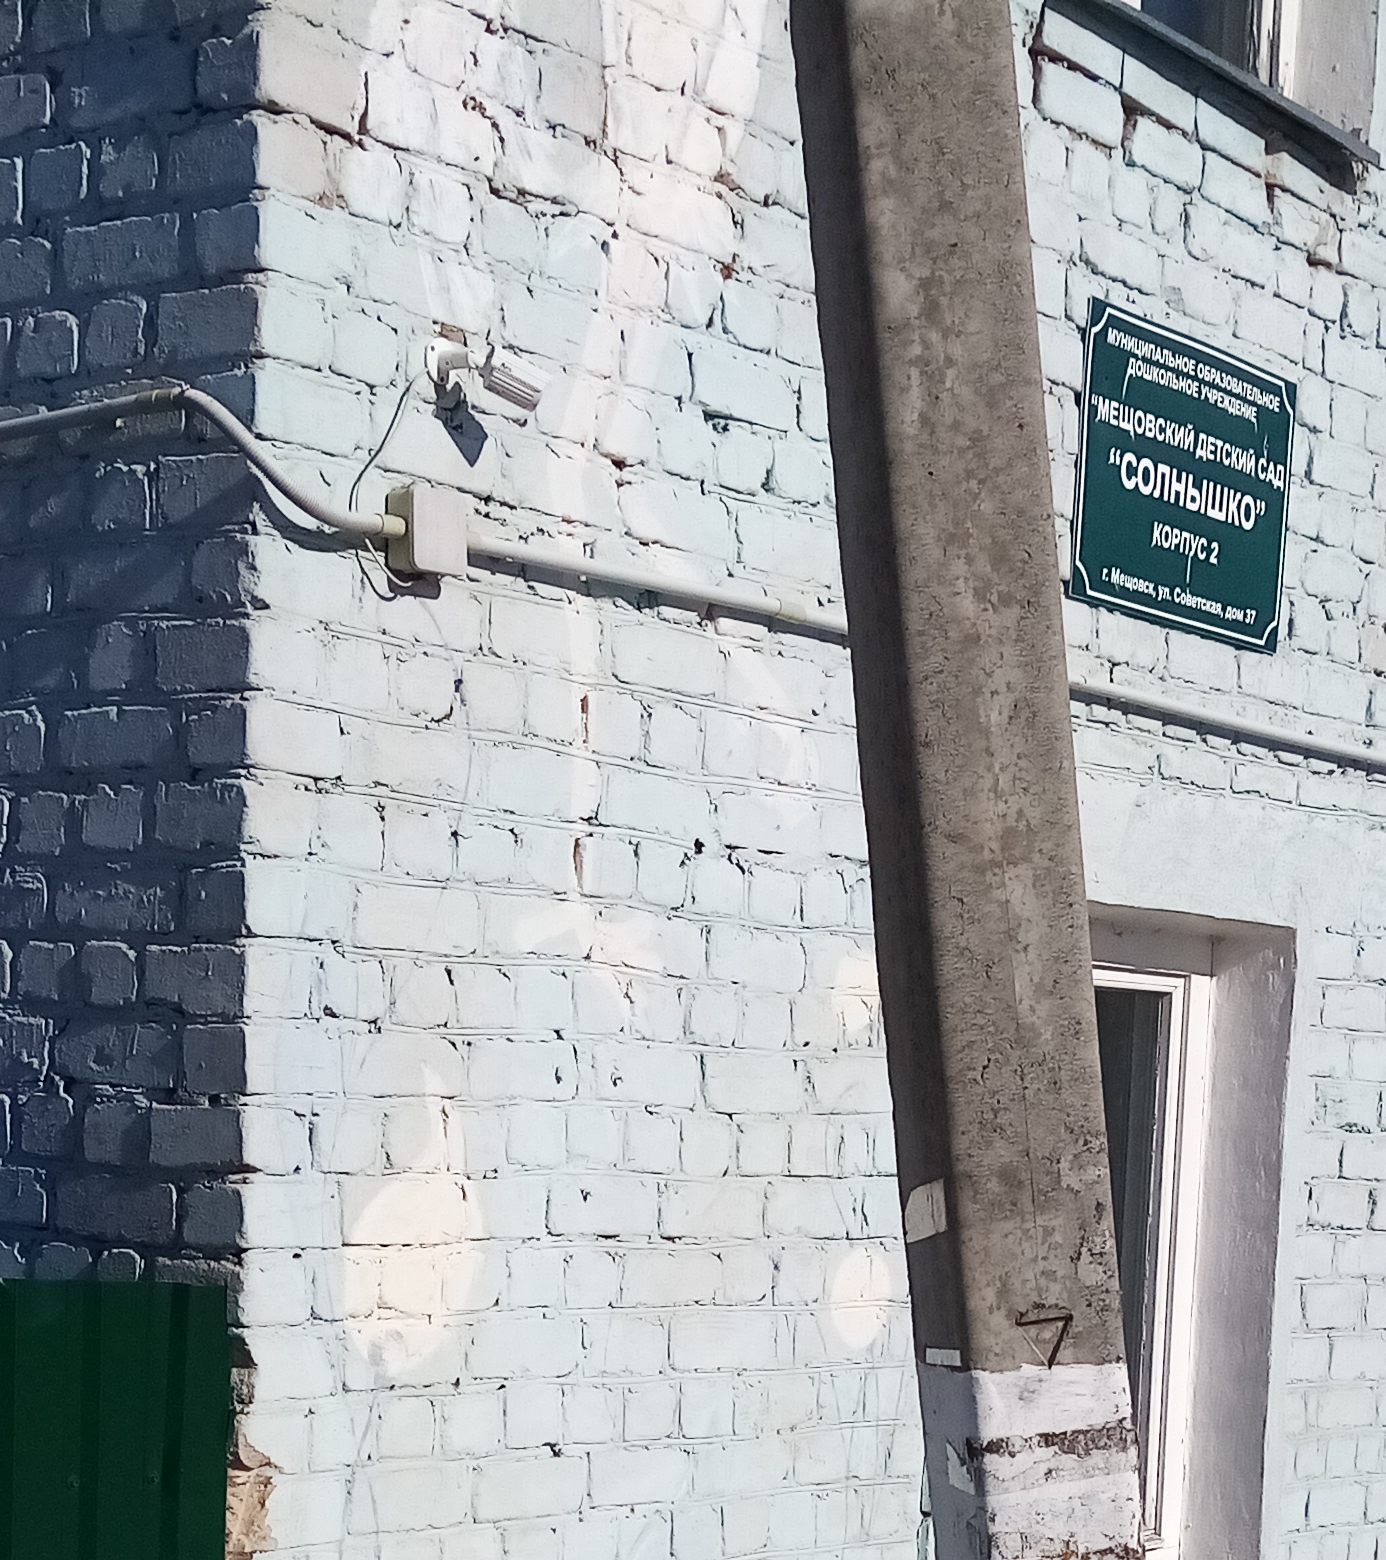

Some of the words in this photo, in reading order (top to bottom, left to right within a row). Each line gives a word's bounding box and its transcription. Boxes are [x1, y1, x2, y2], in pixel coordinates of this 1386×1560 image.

[1107, 327, 1196, 376] МУНИЦИПАЛЬНОЕ
[1196, 362, 1280, 413] ОБРАЗОВАТЕЛЬНОЕ
[1127, 357, 1199, 399] ДОШКОЛЬНОЕ
[1200, 384, 1258, 423] УЧРЕЖДЕНИЕ
[1195, 432, 1256, 478] ДЕТСКИЙ
[1257, 457, 1285, 491] САД
[1152, 521, 1208, 561] КОРПУС
[1209, 541, 1219, 566] 2
[1101, 567, 1109, 581] г.
[1111, 567, 1156, 598] Мещовск,
[1157, 585, 1172, 601] ул.
[1173, 587, 1224, 618] Советская,
[1224, 605, 1244, 622] дом
[1245, 608, 1257, 625] 37
